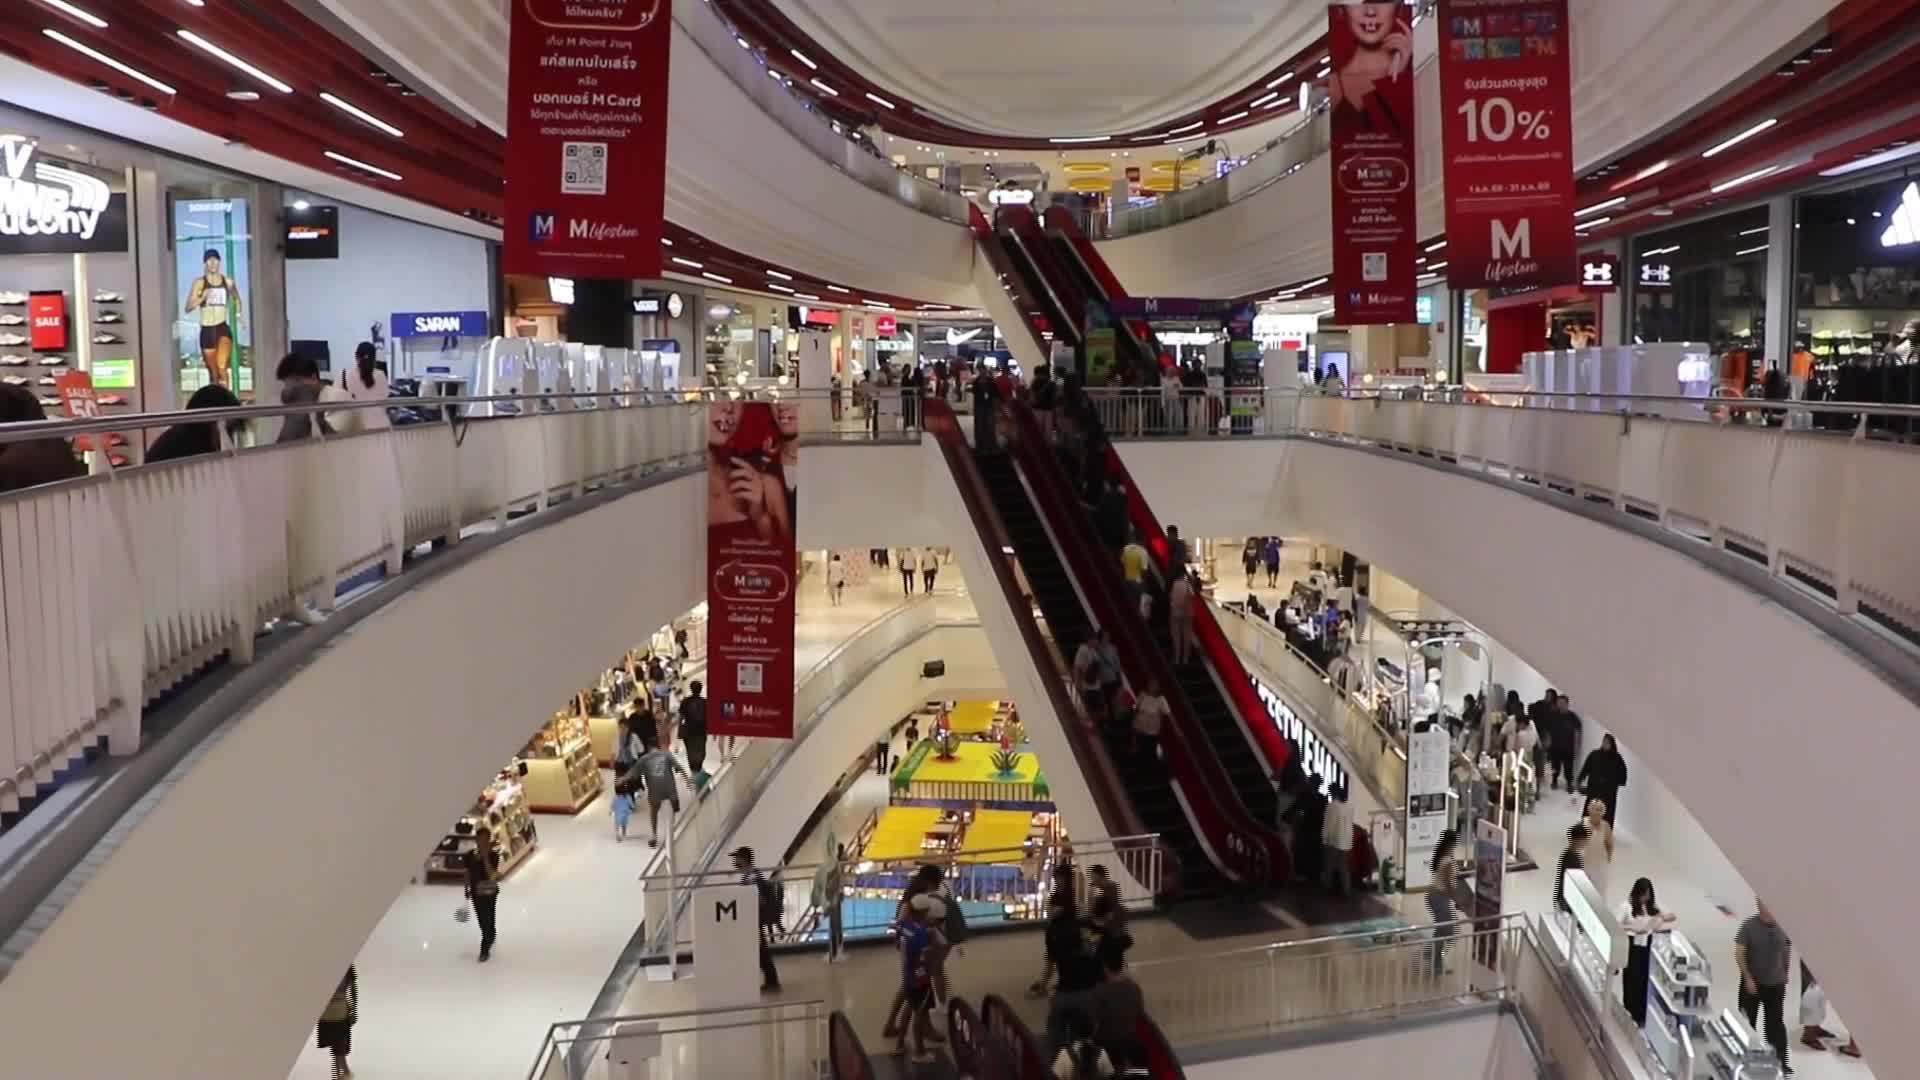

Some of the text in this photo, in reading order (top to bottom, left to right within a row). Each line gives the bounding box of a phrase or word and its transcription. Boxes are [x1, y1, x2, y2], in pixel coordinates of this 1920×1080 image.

[592, 95, 605, 105] M
[607, 95, 641, 107] Card
[570, 219, 588, 238] M
[1490, 218, 1530, 259] M
[35, 317, 60, 327] SALE
[716, 900, 737, 922] M
